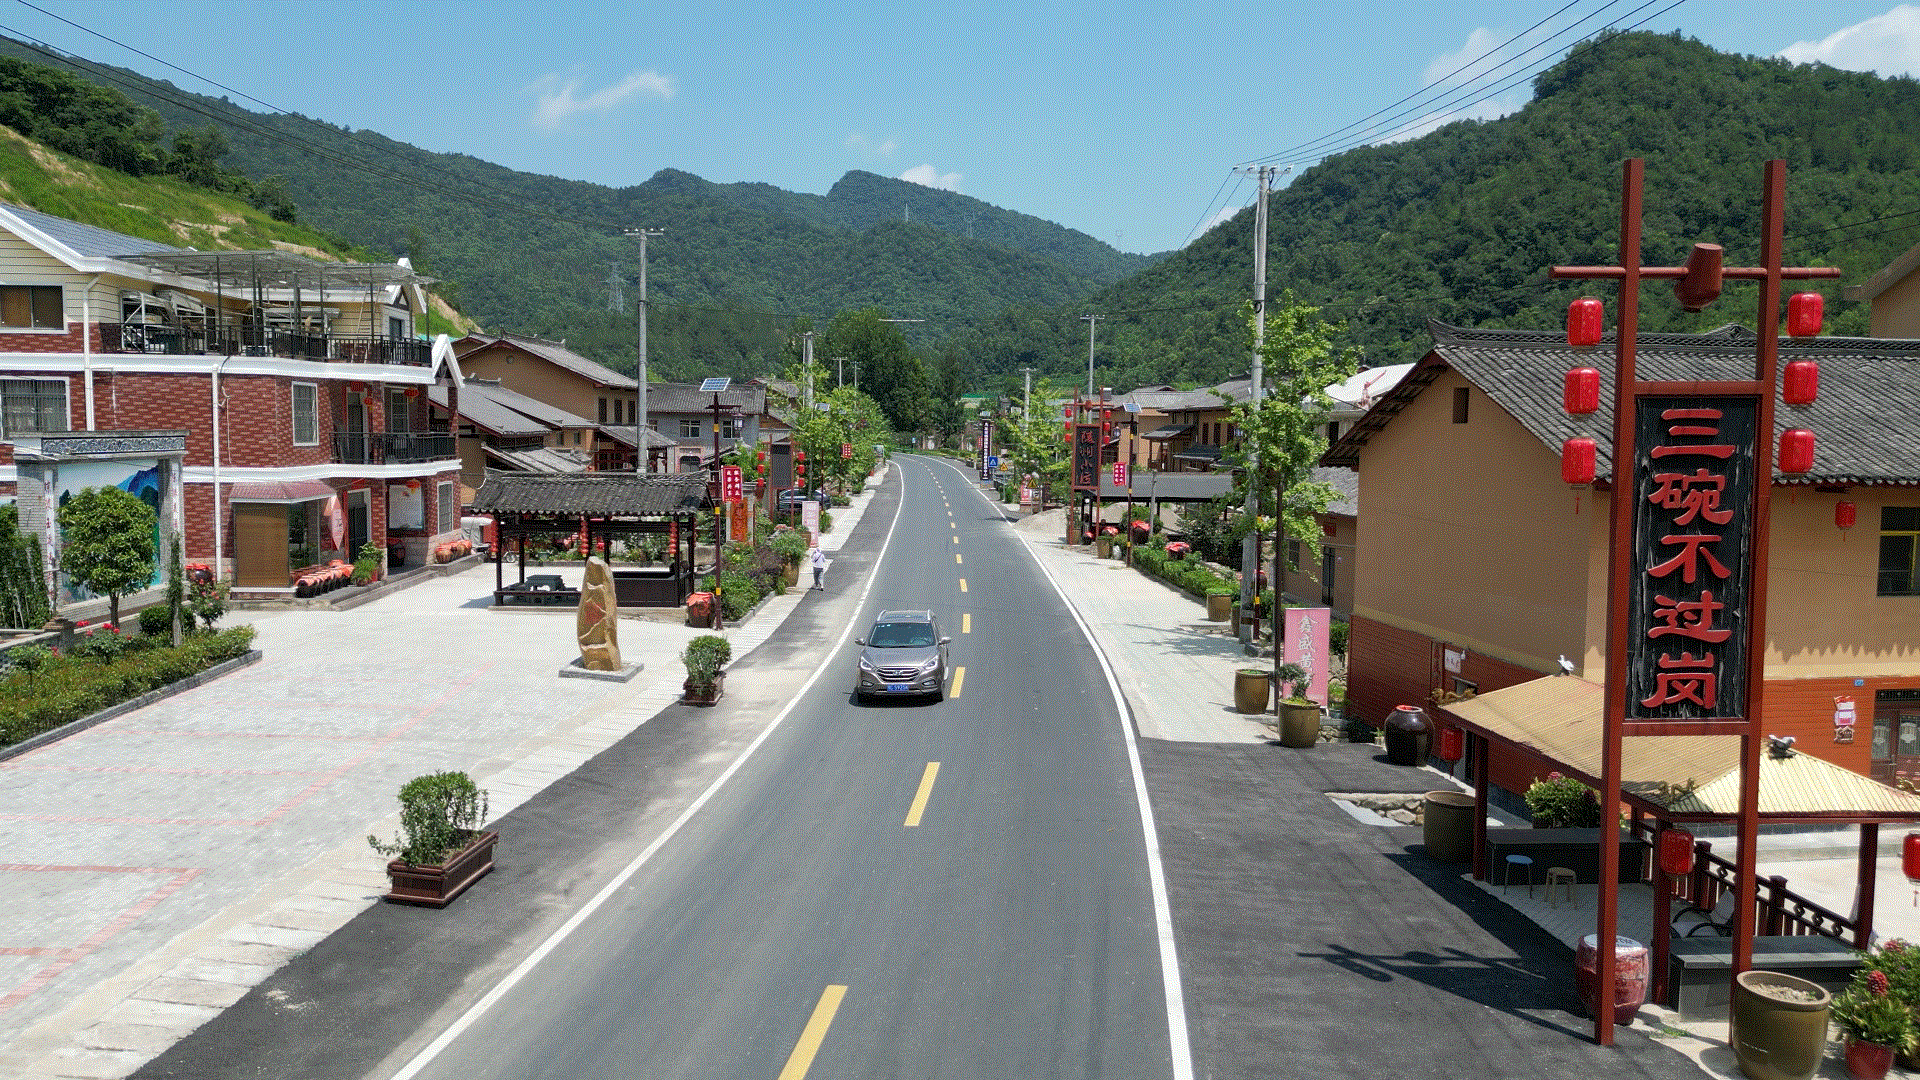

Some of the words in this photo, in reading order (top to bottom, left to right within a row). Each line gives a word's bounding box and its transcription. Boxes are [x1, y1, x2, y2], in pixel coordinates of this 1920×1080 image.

[1641, 408, 1736, 709] 三碗不过岗
